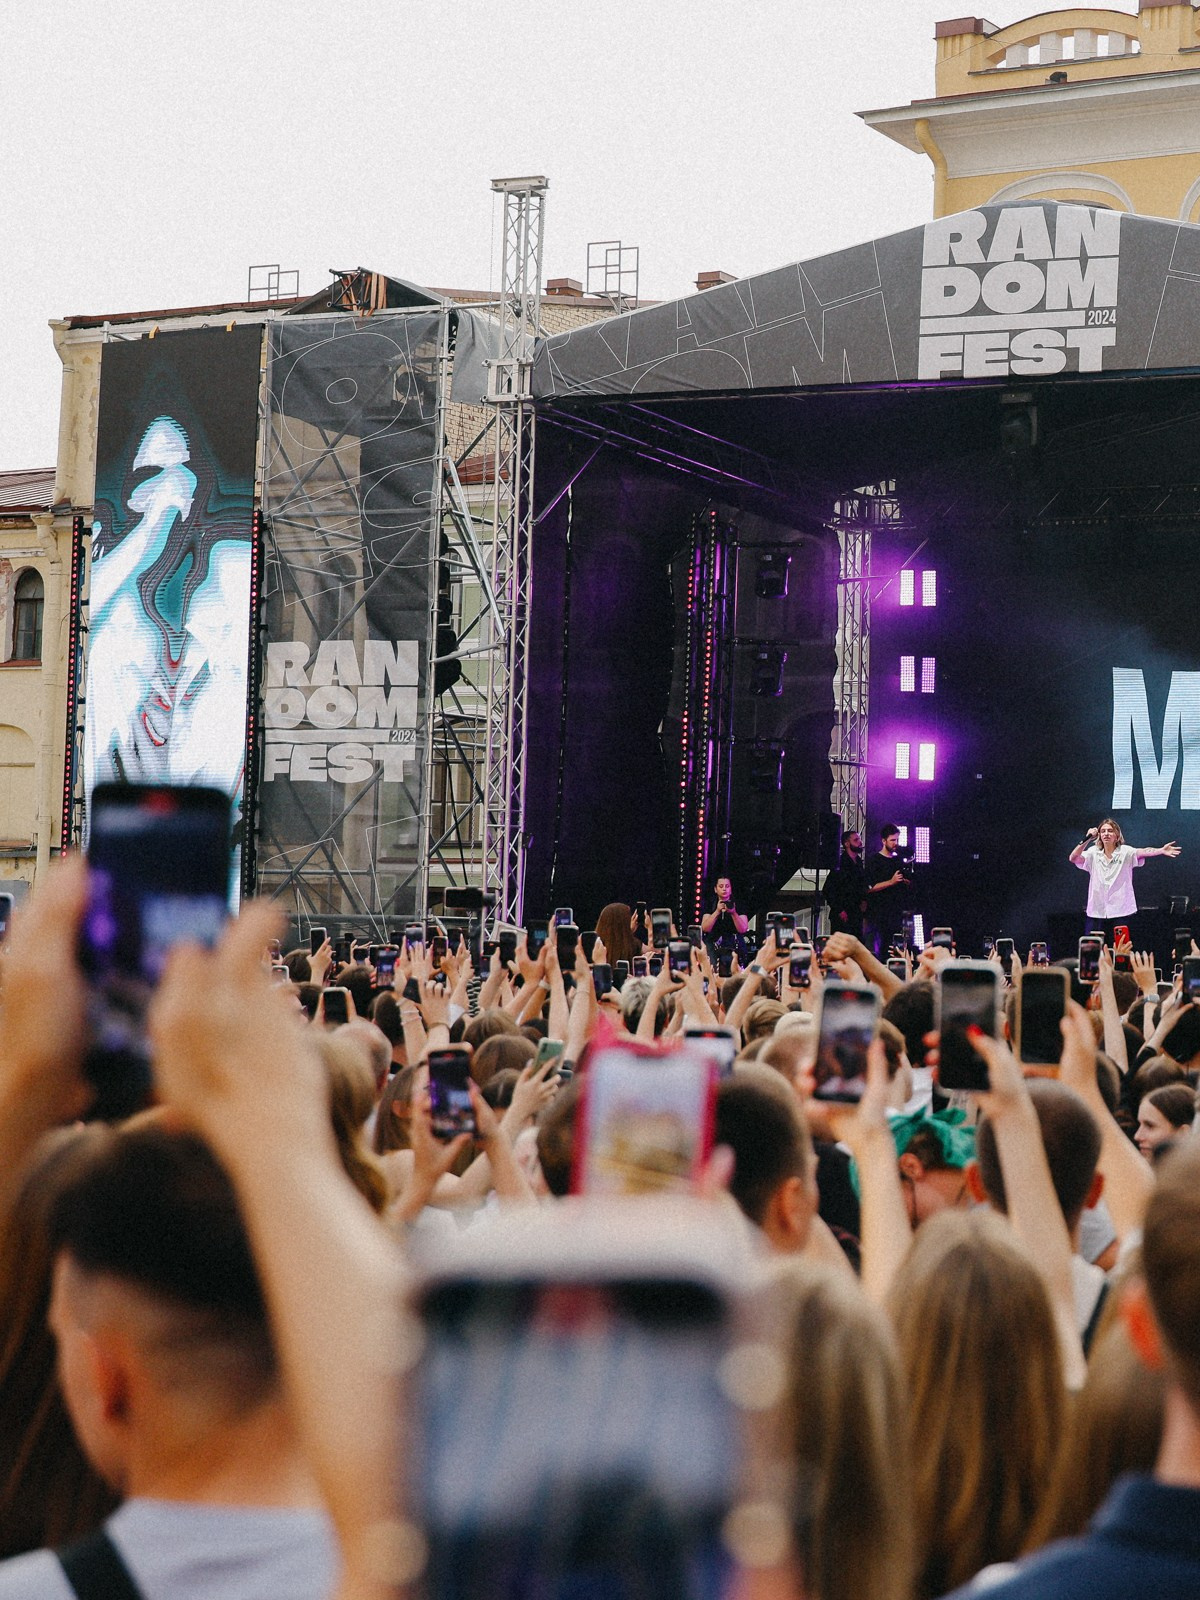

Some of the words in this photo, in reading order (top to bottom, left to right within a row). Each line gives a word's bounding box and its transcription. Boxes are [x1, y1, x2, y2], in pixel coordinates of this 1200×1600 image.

[922, 206, 1121, 266] RAN
[920, 257, 1119, 317] DOM
[1087, 309, 1117, 326] 2024
[918, 327, 1116, 380] FEST
[267, 640, 419, 687] RAN
[264, 685, 418, 729] DOM
[390, 729, 417, 743] 2024
[264, 743, 415, 784] FEST
